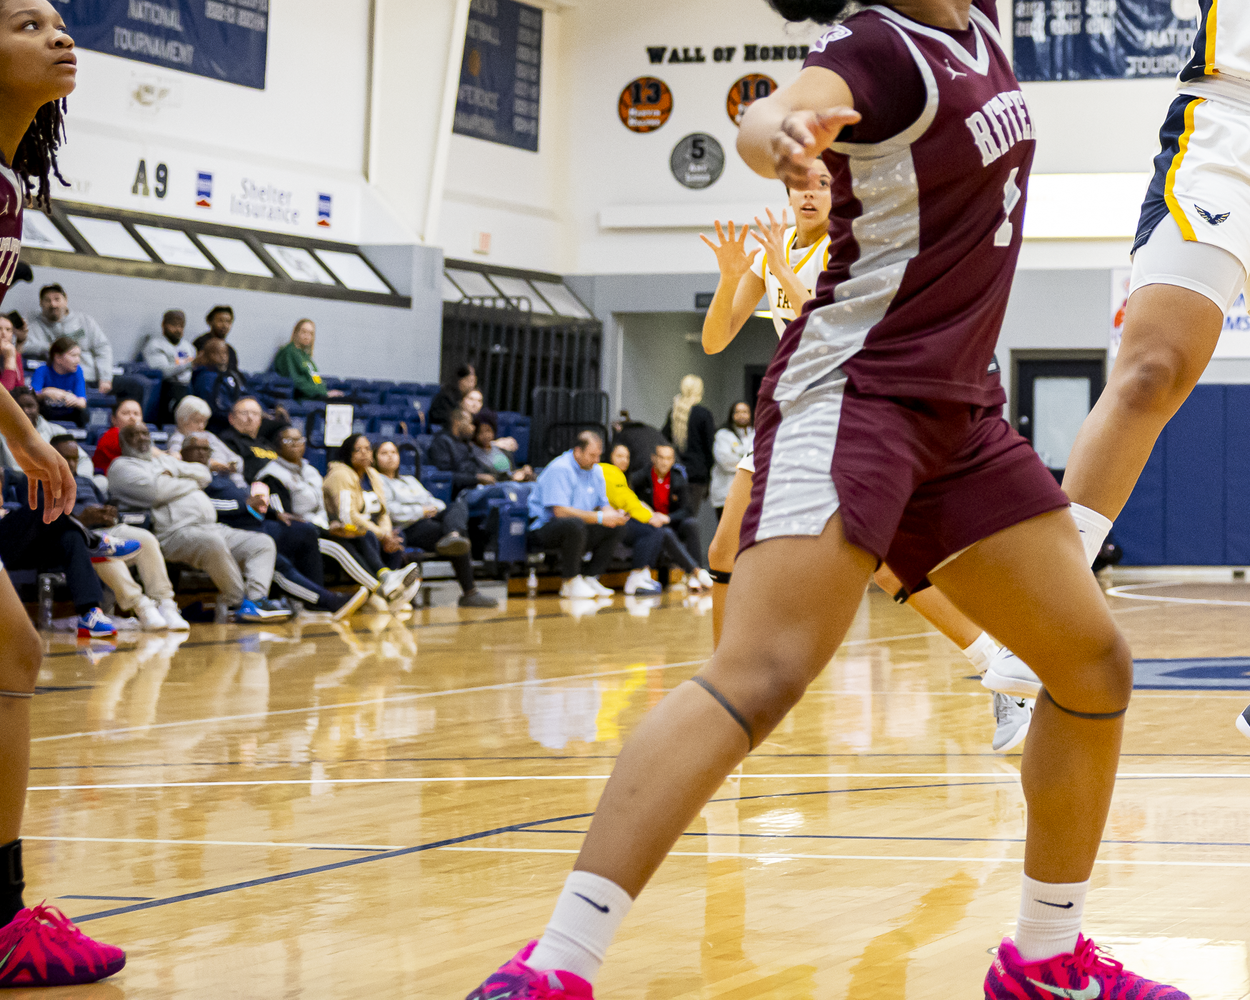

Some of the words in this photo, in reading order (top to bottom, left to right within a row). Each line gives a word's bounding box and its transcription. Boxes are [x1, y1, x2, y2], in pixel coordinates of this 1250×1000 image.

[646, 46, 706, 64] WALL
[713, 47, 736, 62] OF
[632, 81, 662, 105] 13
[691, 138, 705, 160] 5
[240, 177, 292, 206] Shelter
[230, 193, 300, 226] Insurance
